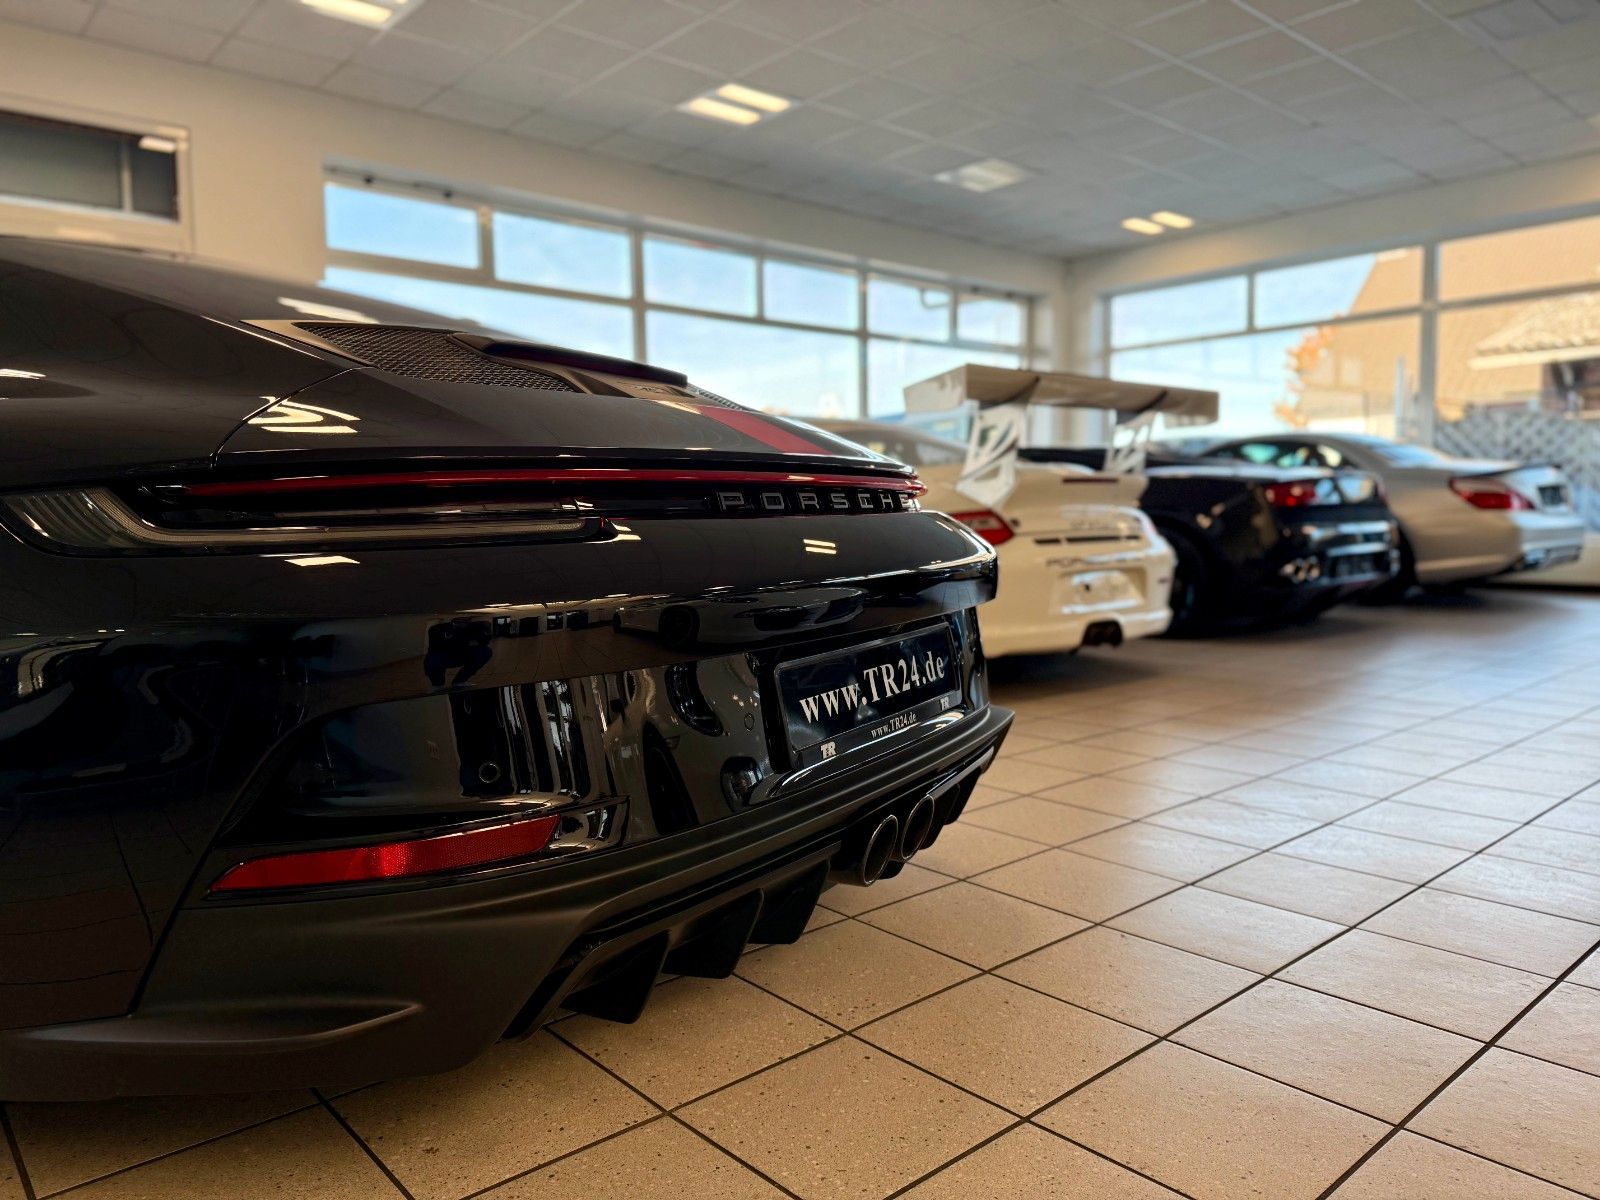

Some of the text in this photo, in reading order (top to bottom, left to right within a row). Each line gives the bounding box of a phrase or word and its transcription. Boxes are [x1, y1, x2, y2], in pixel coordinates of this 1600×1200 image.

[718, 491, 910, 511] PORSCHE
[799, 651, 945, 724] www.TR24.de
[870, 712, 917, 739] www.TR24.de
[820, 741, 837, 759] TR
